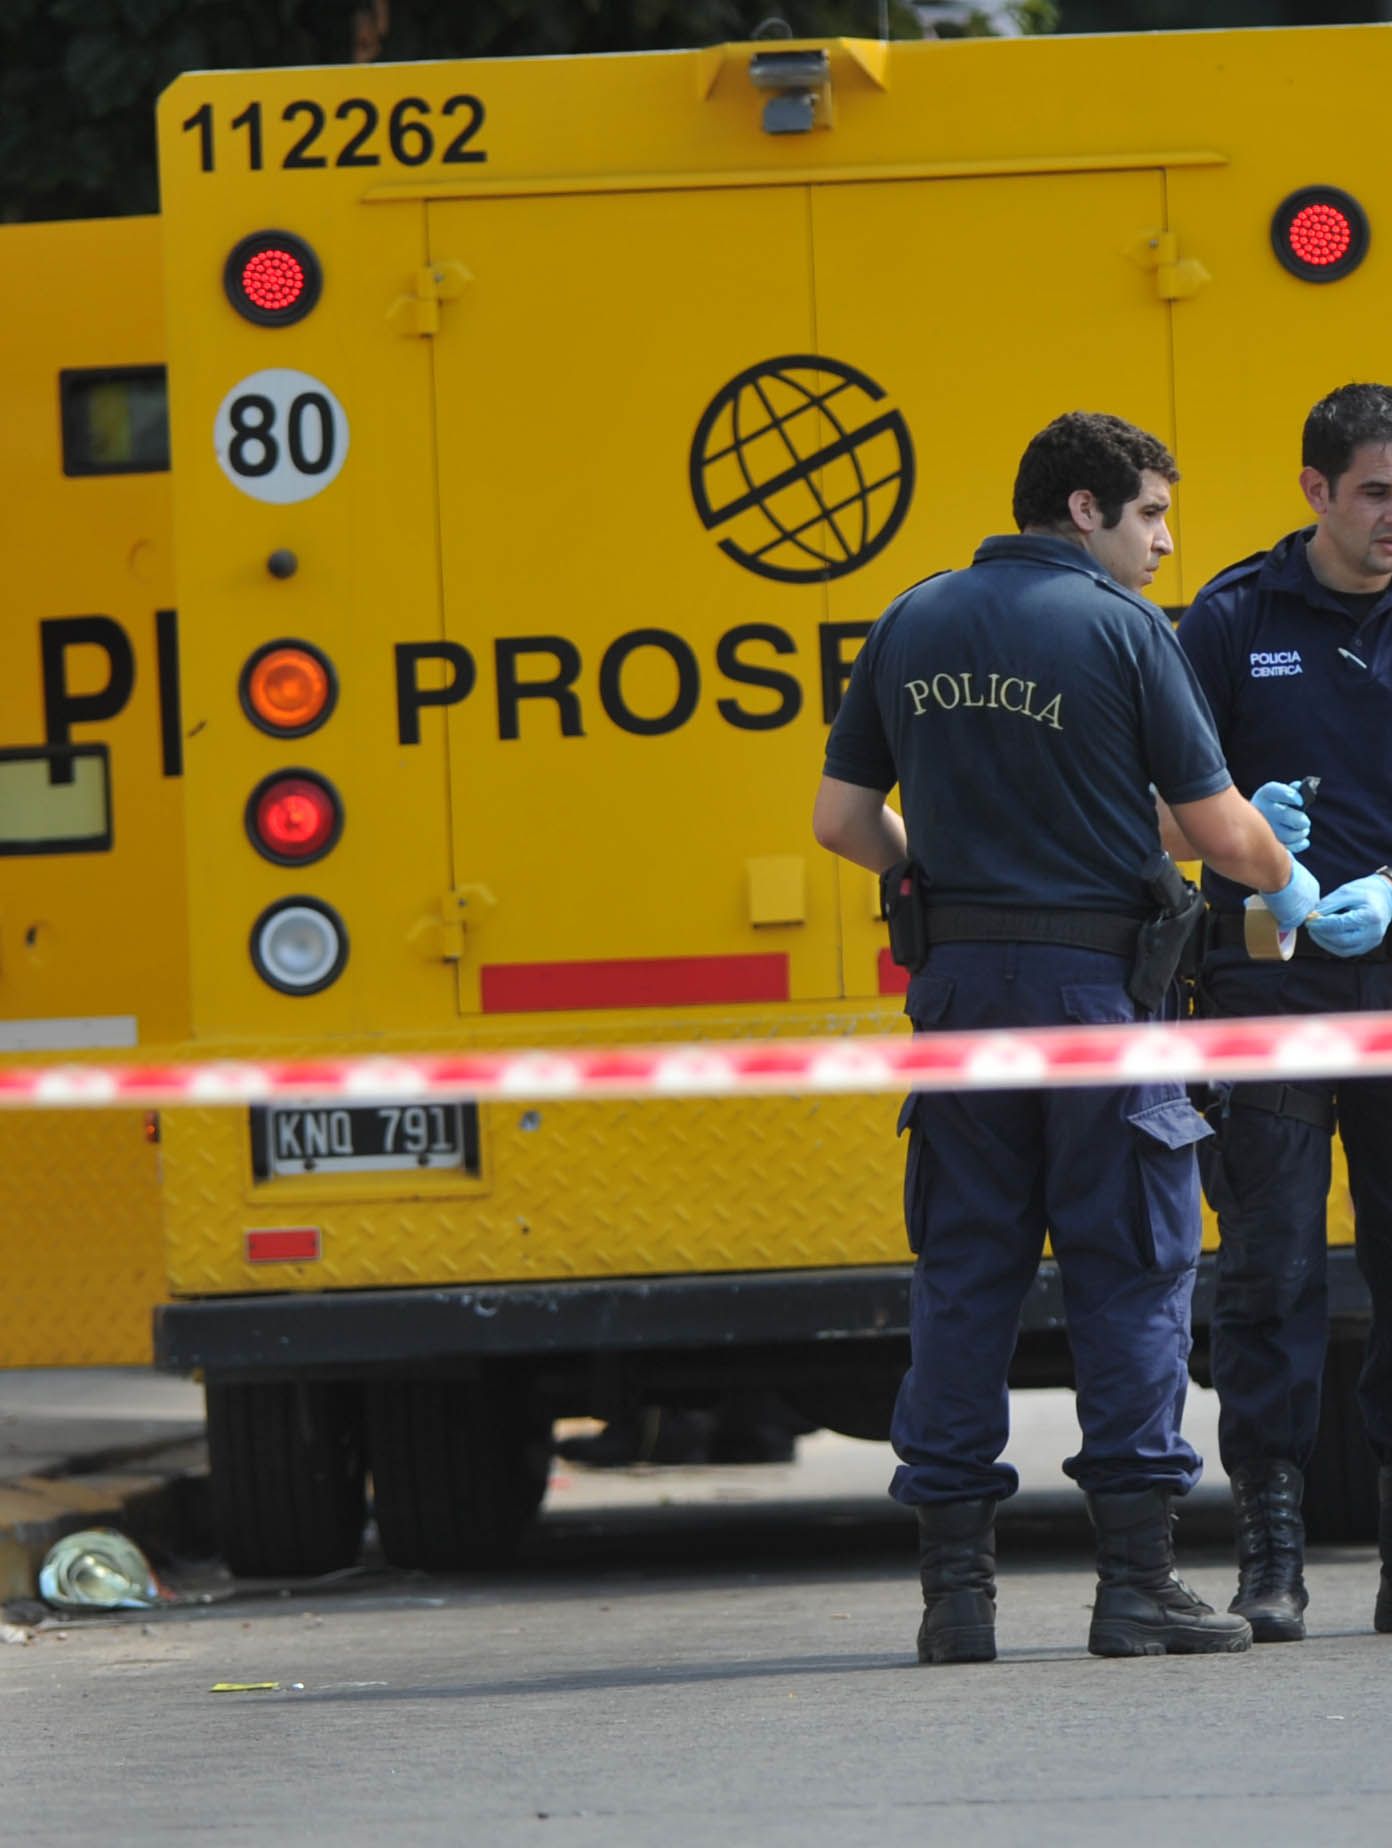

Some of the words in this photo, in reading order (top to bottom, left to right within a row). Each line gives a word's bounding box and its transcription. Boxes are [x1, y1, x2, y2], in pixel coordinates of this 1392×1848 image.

[182, 94, 488, 172] 112262
[229, 392, 335, 477] 80
[1250, 650, 1302, 665] POLICIA
[904, 672, 1064, 730] POLICIA
[278, 1110, 353, 1156] KNQ
[378, 1105, 452, 1152] 791
